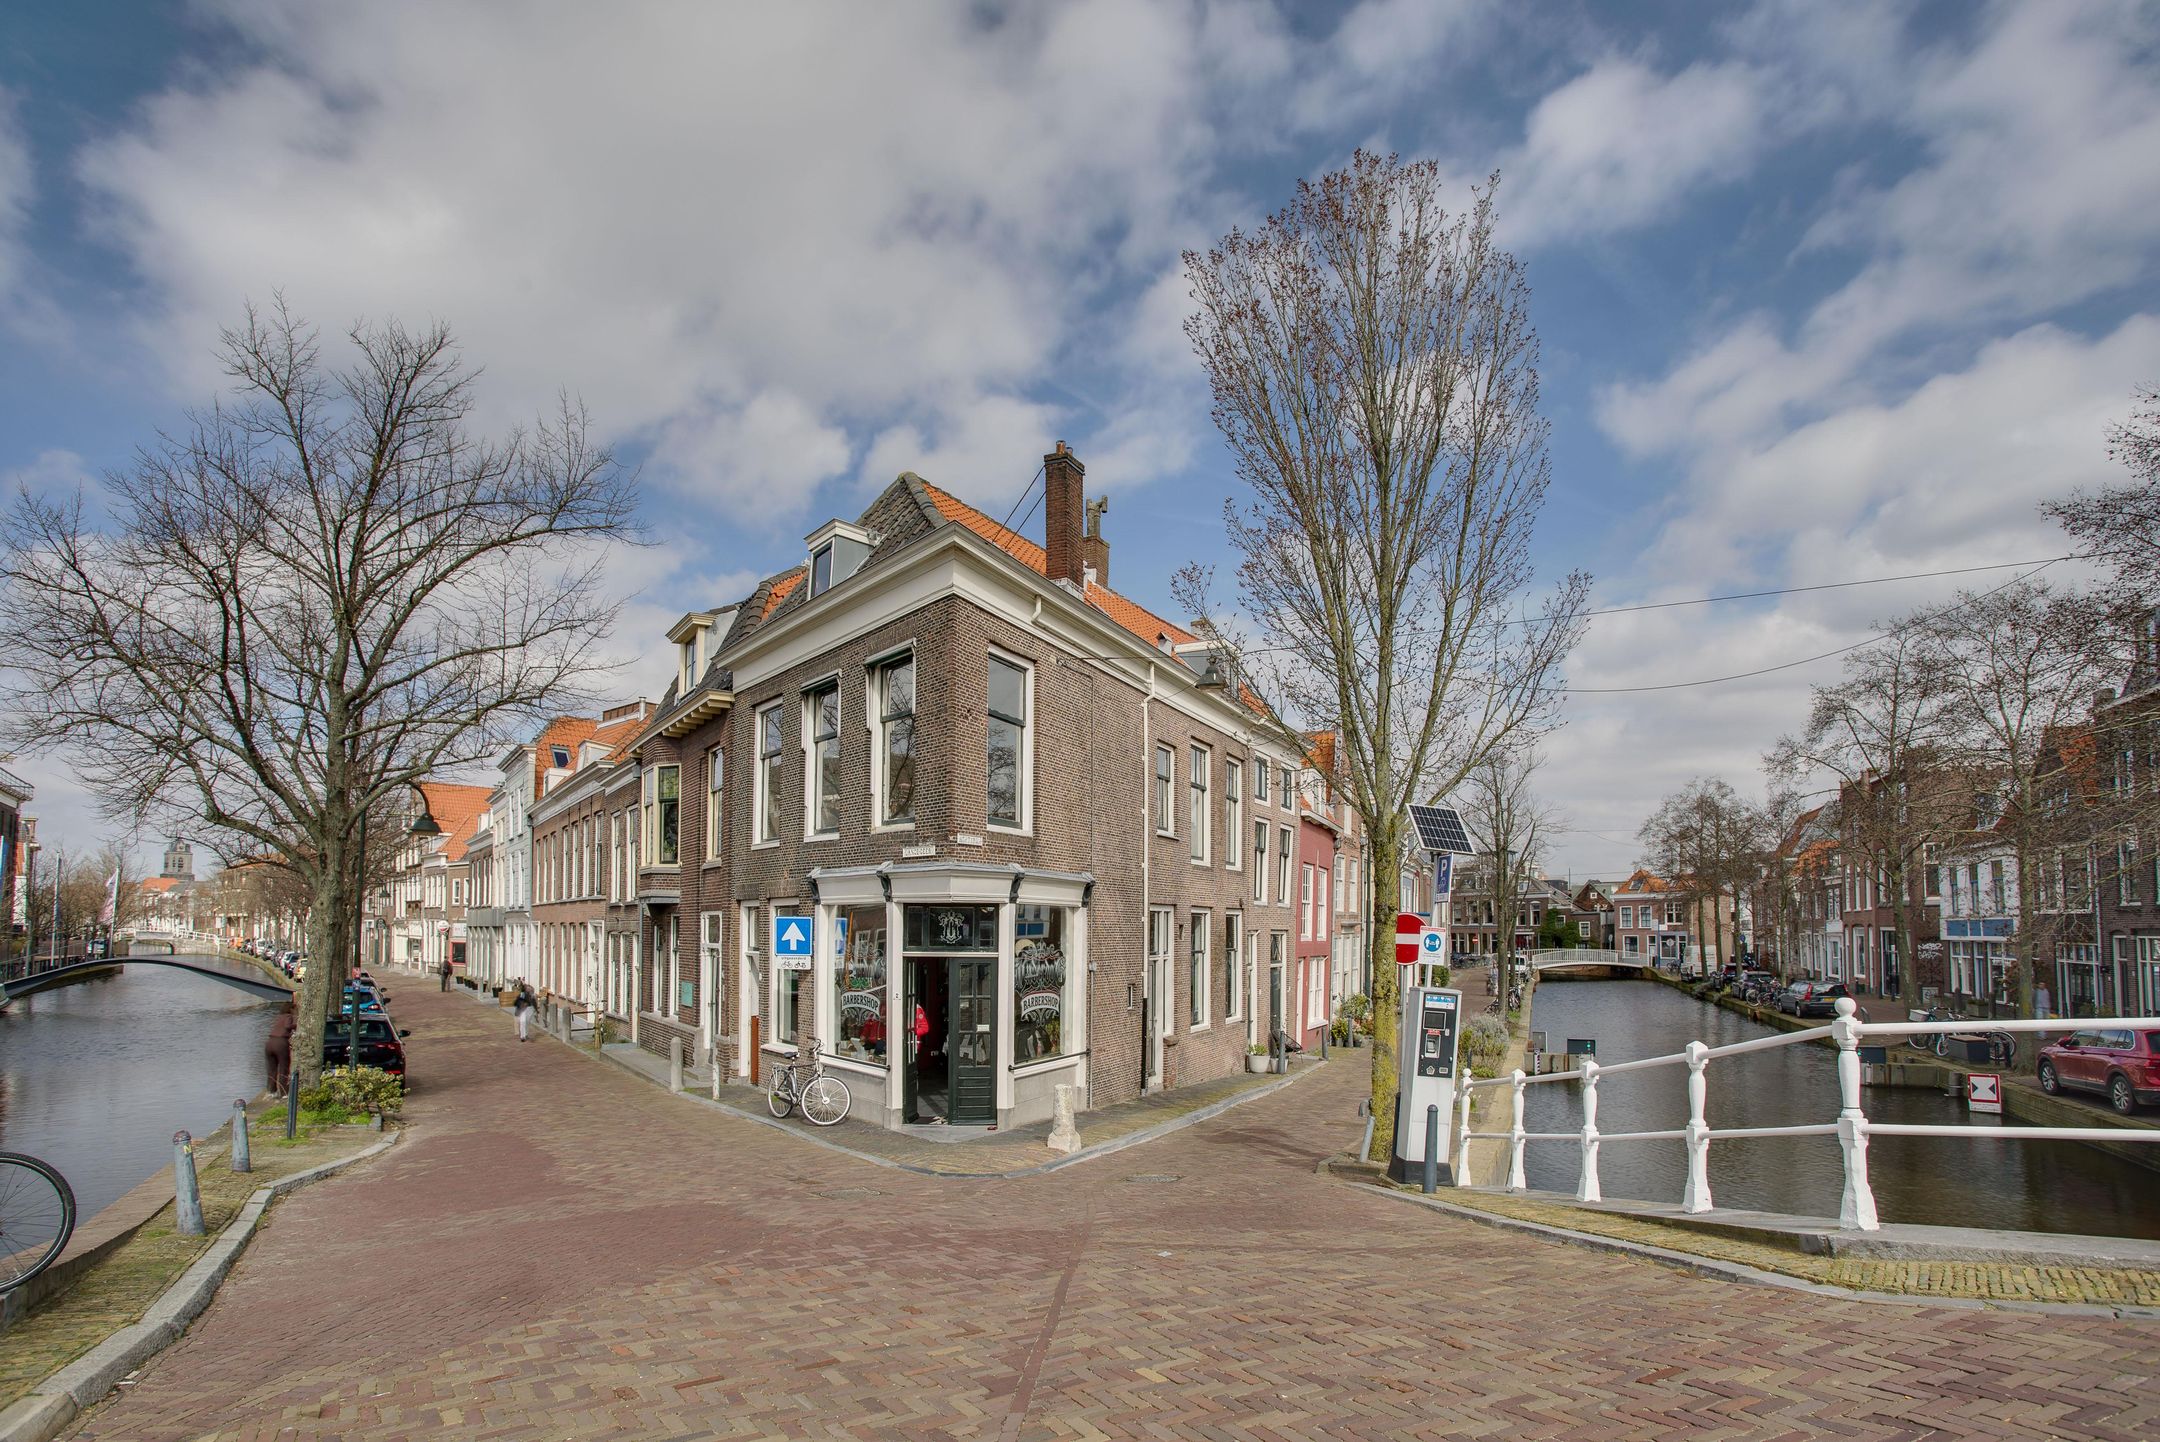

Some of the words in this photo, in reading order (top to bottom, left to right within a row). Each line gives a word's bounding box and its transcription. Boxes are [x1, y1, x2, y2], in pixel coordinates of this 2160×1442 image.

[1441, 860, 1448, 877] P
[842, 994, 879, 1010] BARBERSHOP
[1023, 995, 1059, 1011] BARBERSHOP
